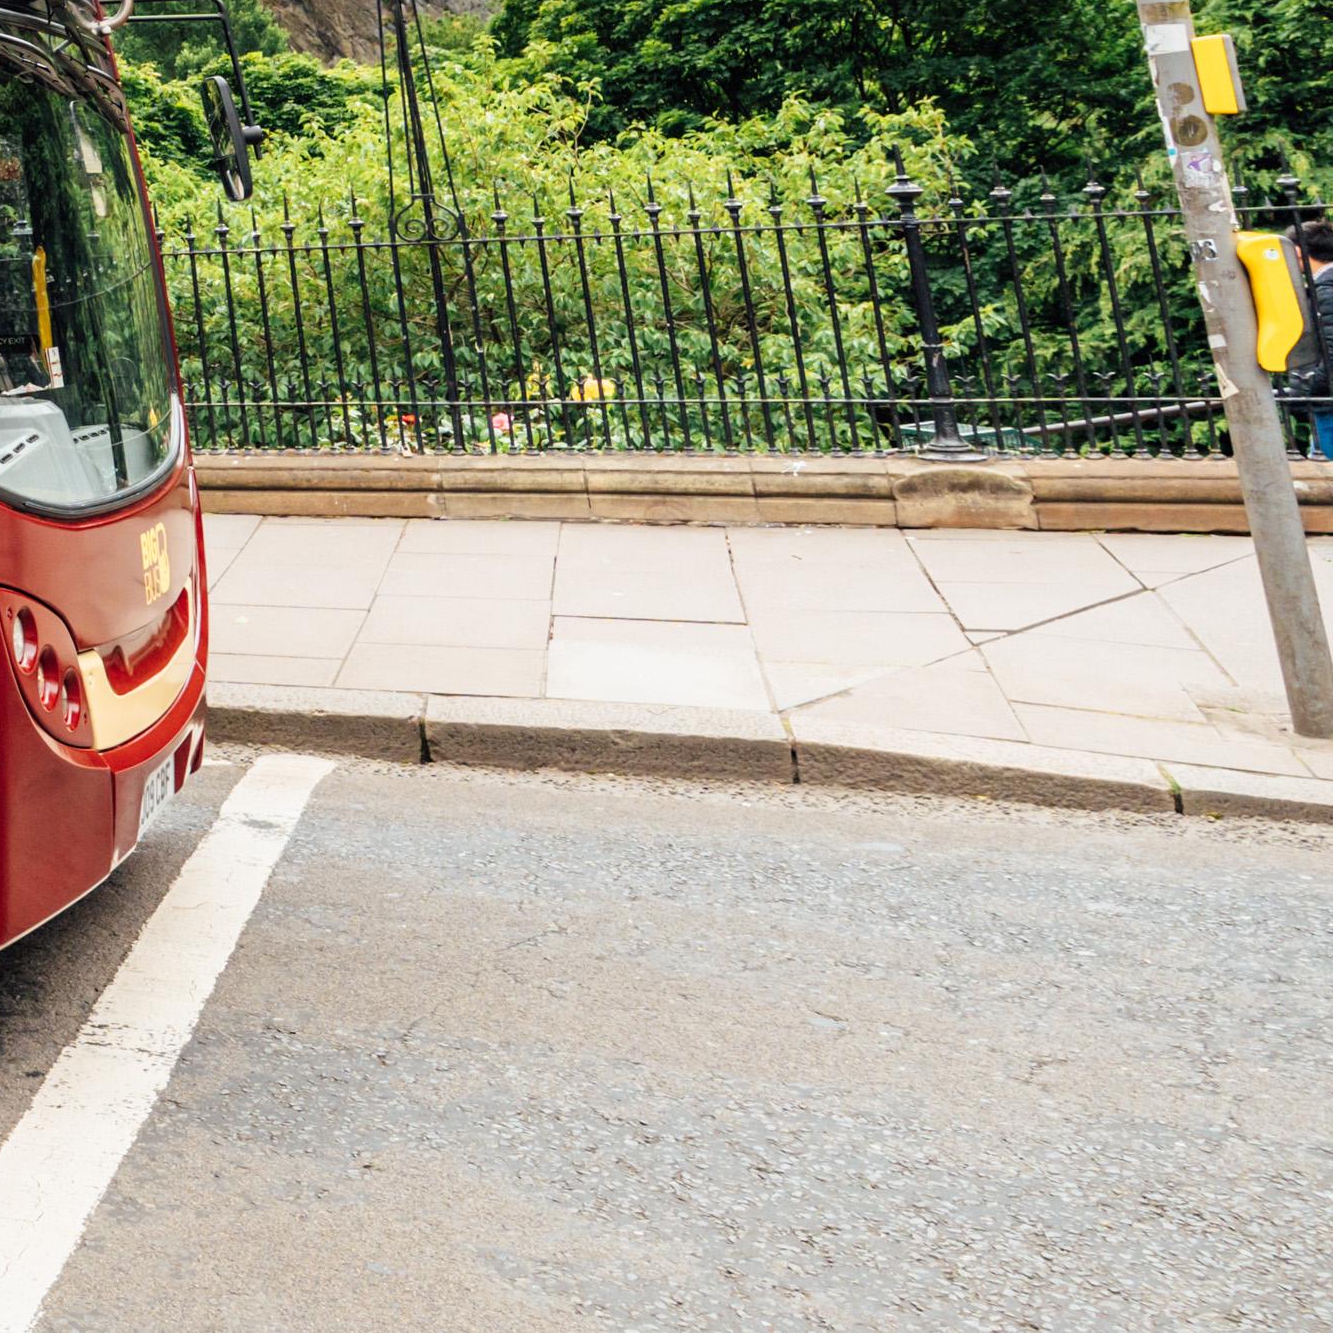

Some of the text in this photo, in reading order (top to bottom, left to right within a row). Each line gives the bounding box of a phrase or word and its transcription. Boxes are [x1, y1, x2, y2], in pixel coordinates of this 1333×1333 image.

[8, 336, 25, 345] EXIT
[140, 527, 158, 571] BIG
[144, 565, 162, 606] BUS
